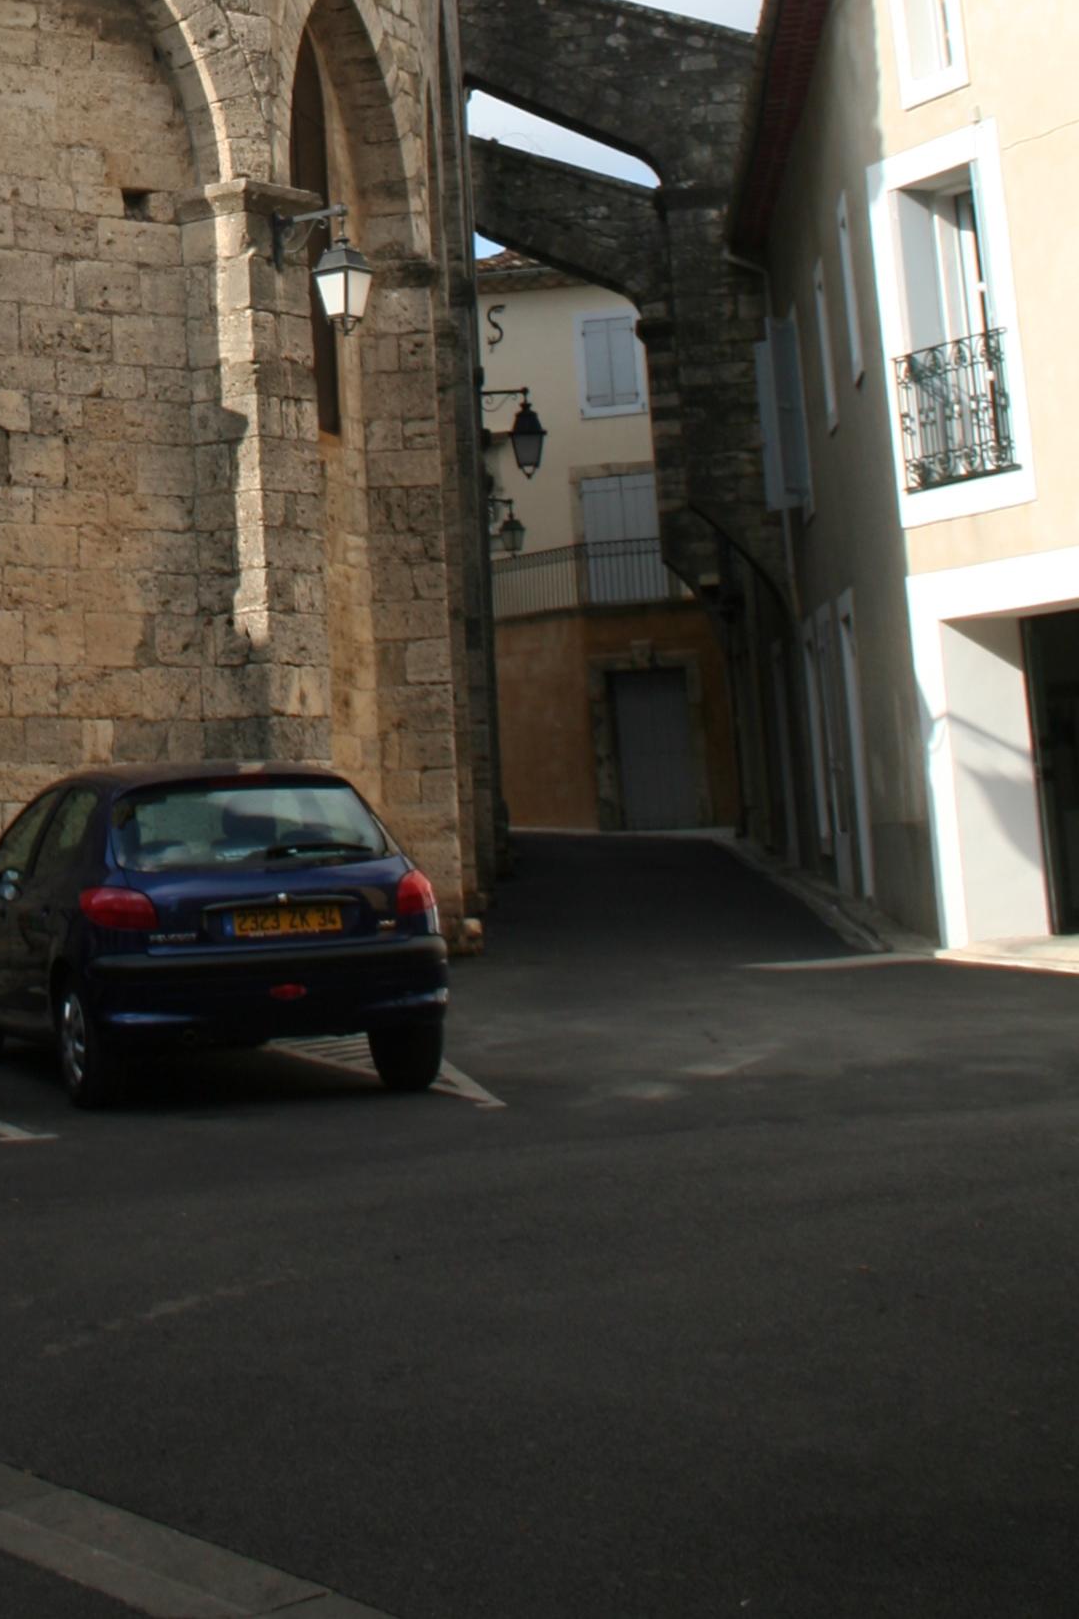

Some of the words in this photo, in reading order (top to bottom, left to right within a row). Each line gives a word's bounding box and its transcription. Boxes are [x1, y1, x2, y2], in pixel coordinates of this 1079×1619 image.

[237, 910, 280, 932] 2323
[288, 908, 311, 929] ZK
[317, 906, 339, 927] 34
